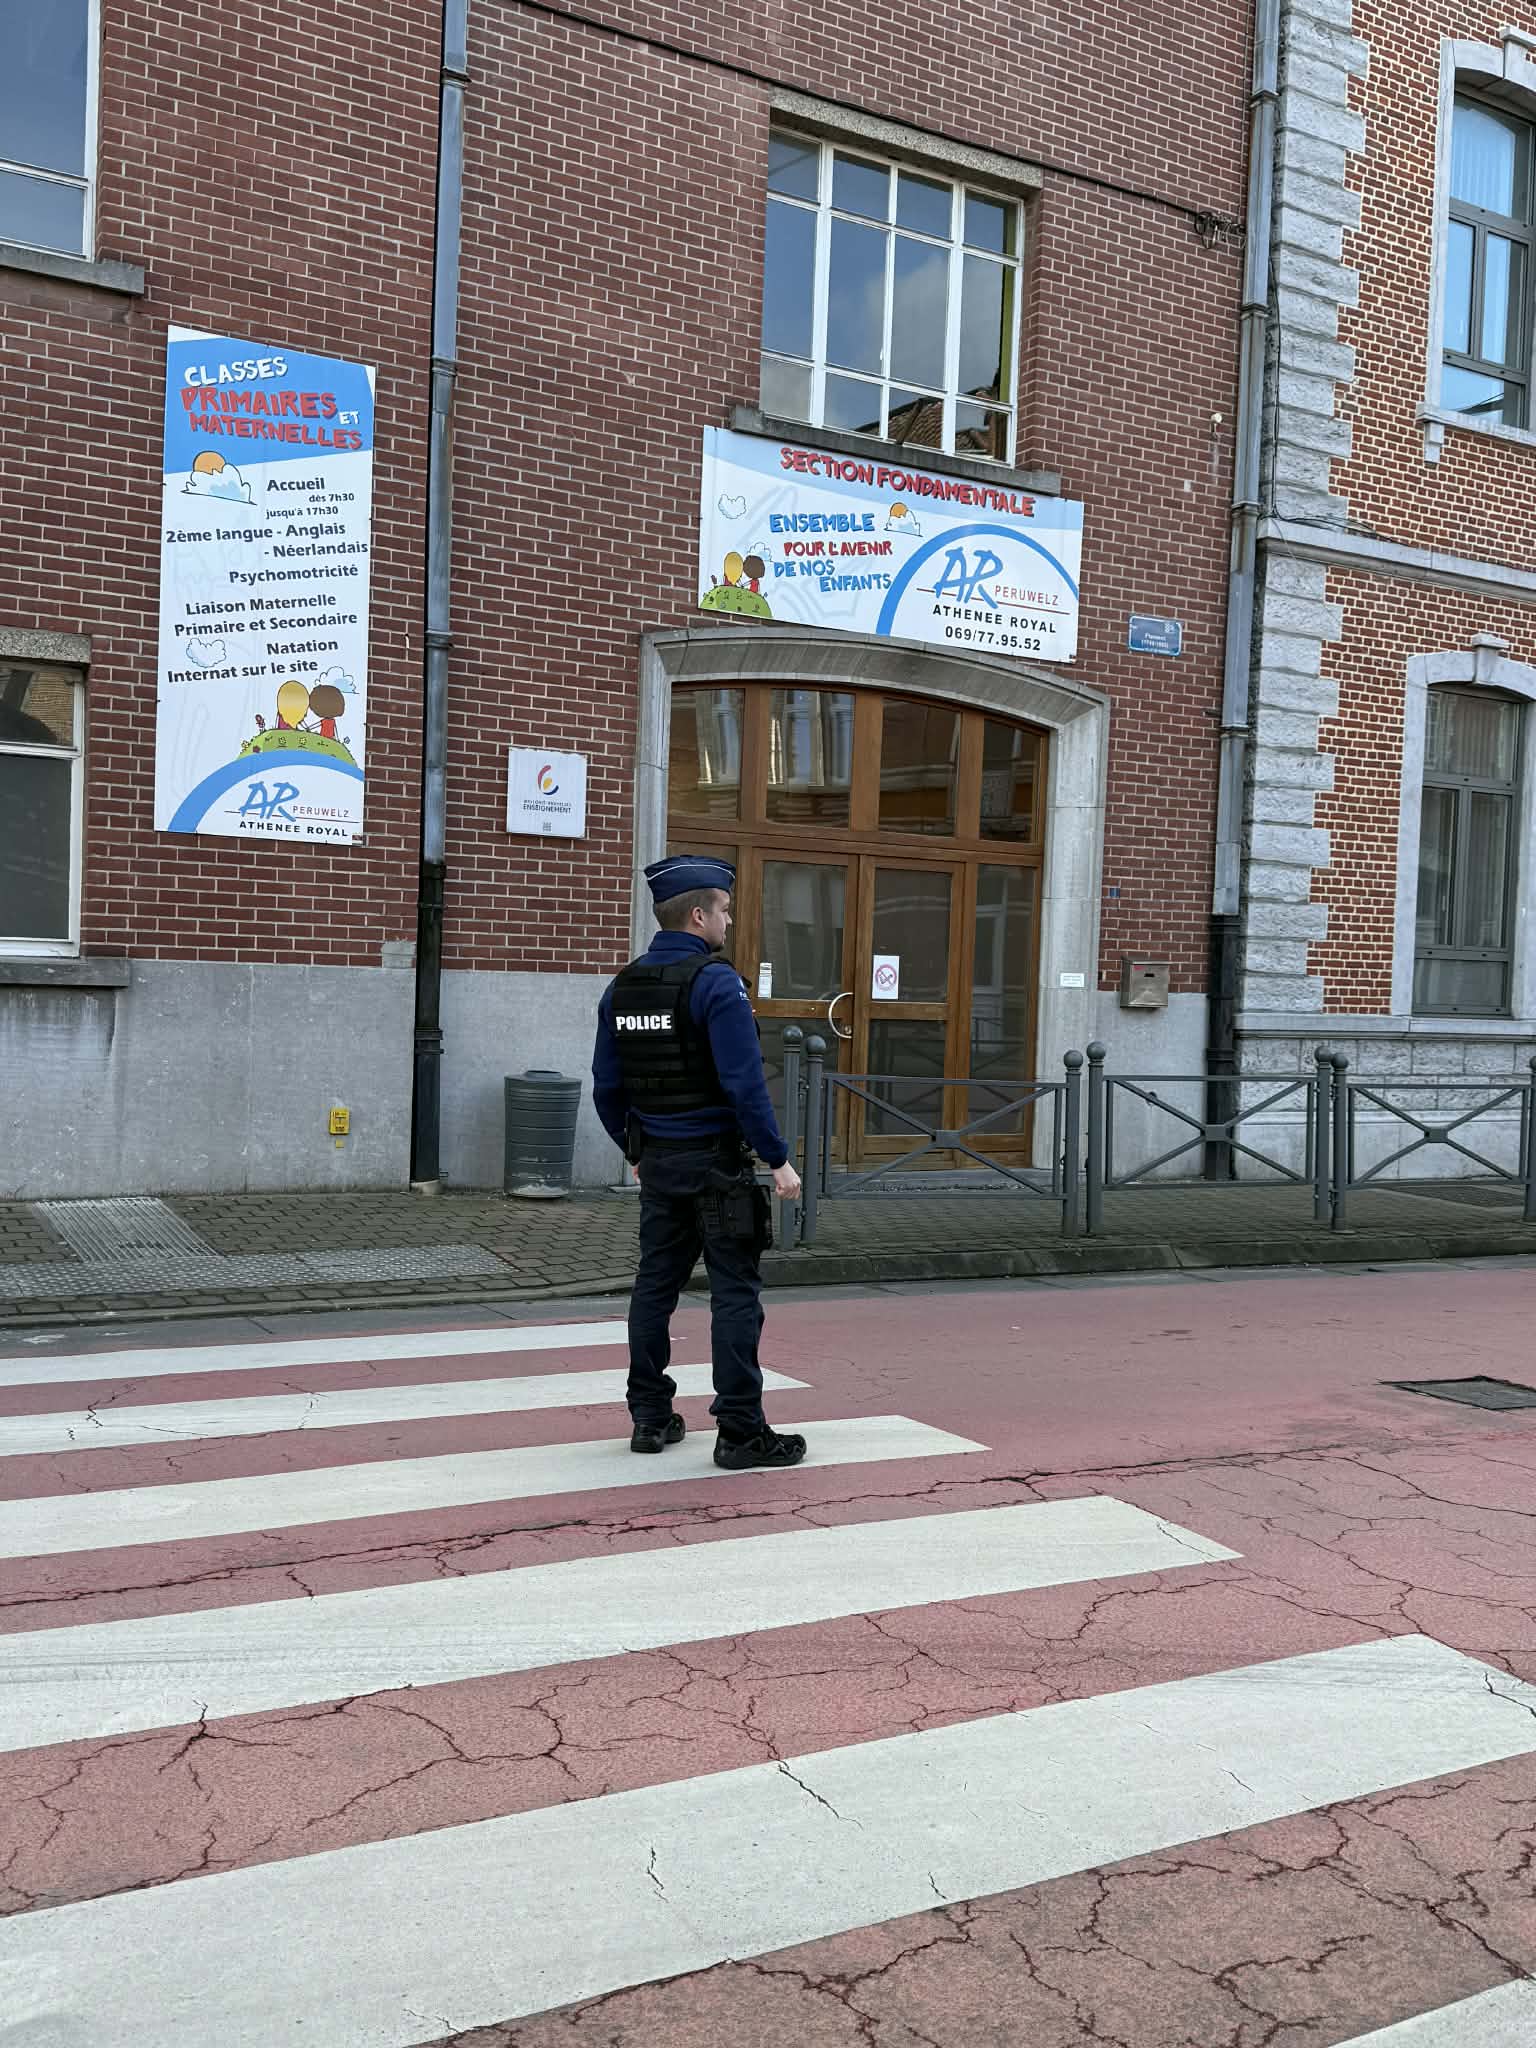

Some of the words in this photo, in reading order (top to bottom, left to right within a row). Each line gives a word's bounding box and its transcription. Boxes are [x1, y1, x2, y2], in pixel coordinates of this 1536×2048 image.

[184, 356, 288, 387] CLASSES
[180, 386, 339, 420] PRIMAIRES
[339, 410, 360, 425] ET
[189, 413, 363, 450] MATERNELLES
[267, 477, 325, 492] Accueil
[780, 447, 874, 486] SECTION
[876, 467, 1036, 518] FONDAMENTALE
[308, 493, 326, 502] dès
[328, 493, 355, 503] 7h30
[265, 506, 303, 520] jusqu'à
[306, 505, 339, 516] 17h30
[769, 512, 876, 533] ENSEMBLE
[166, 528, 212, 543] 2ème
[216, 527, 273, 545] langue
[286, 522, 346, 540] Anglais
[273, 541, 369, 558] Néerlandais
[783, 541, 826, 557] POUR
[829, 541, 893, 556] L'AVENIR
[229, 563, 359, 586] Psychomotricité
[774, 560, 797, 578] DE
[799, 559, 836, 576] NOS
[932, 546, 1004, 610] AR
[819, 573, 892, 593] ENFANTS
[185, 602, 246, 616] Liaison
[249, 594, 337, 611] Maternelle
[994, 585, 1059, 606] PERUWELZ
[174, 621, 245, 637] Primaire
[249, 619, 266, 631] et
[269, 613, 358, 630] Secondaire
[932, 604, 1003, 625] ATHENEE
[1010, 616, 1057, 634] ROYAL
[266, 640, 339, 655] Natation
[945, 625, 1041, 651] 069/77.95.52
[167, 666, 237, 683] Internat
[241, 665, 267, 677] sur
[271, 662, 286, 674] le
[290, 660, 318, 673] site
[238, 781, 300, 822] AR
[292, 805, 350, 818] PERUWELZ
[239, 821, 301, 834] ATHENEE
[306, 826, 349, 837] ROYAL
[615, 1014, 672, 1031] POLICE
